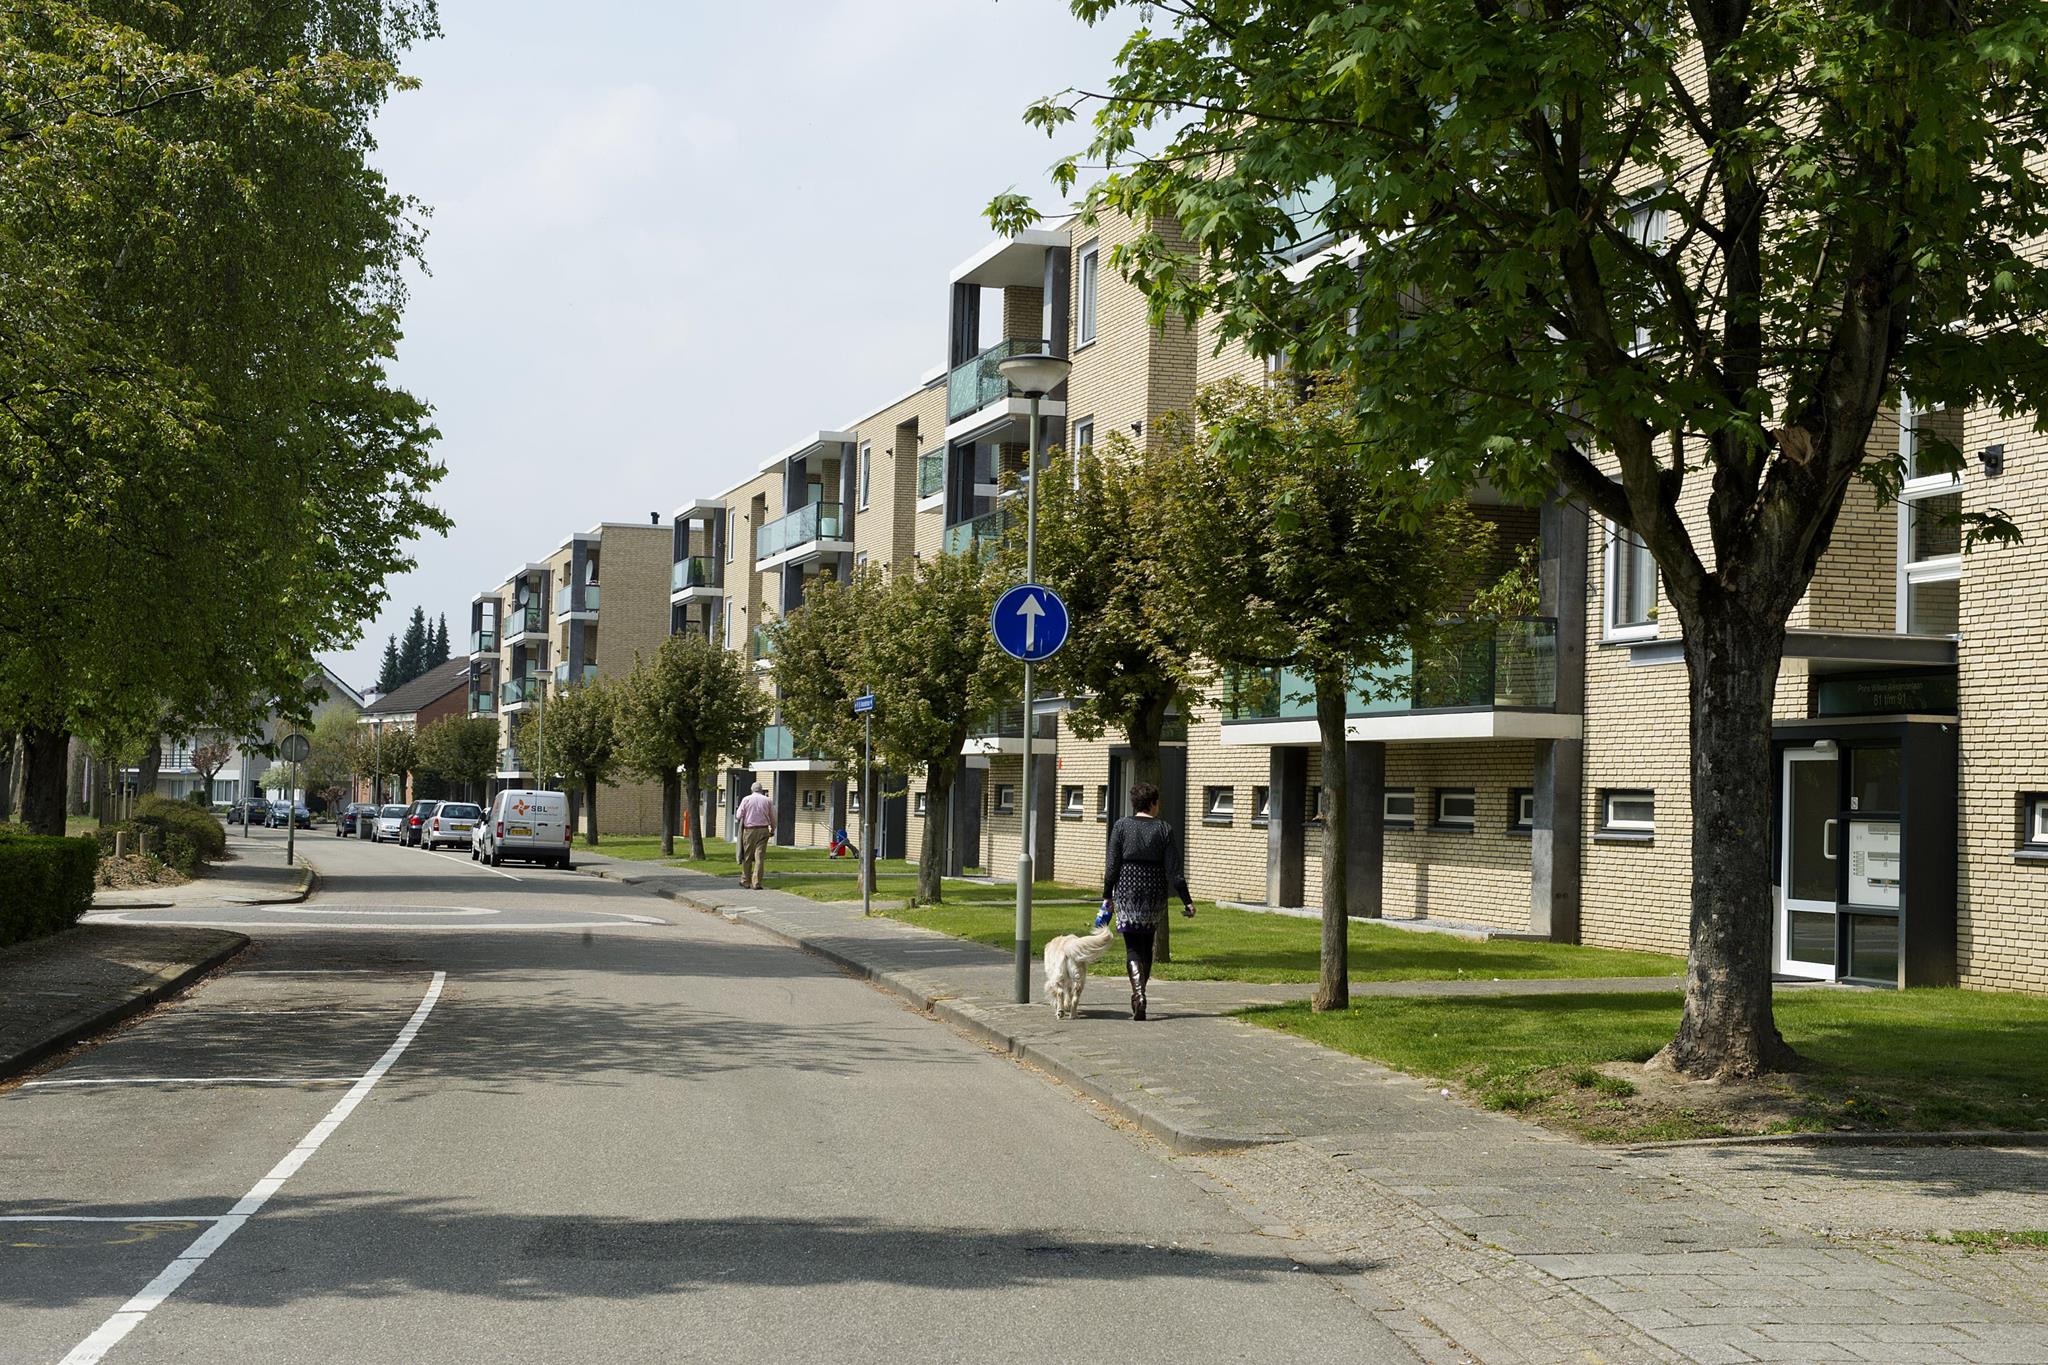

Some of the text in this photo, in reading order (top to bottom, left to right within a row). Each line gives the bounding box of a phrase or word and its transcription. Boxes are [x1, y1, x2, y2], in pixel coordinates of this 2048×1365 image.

[1873, 694, 1882, 706] 81
[1897, 693, 1906, 704] 91
[531, 805, 548, 813] SBL
